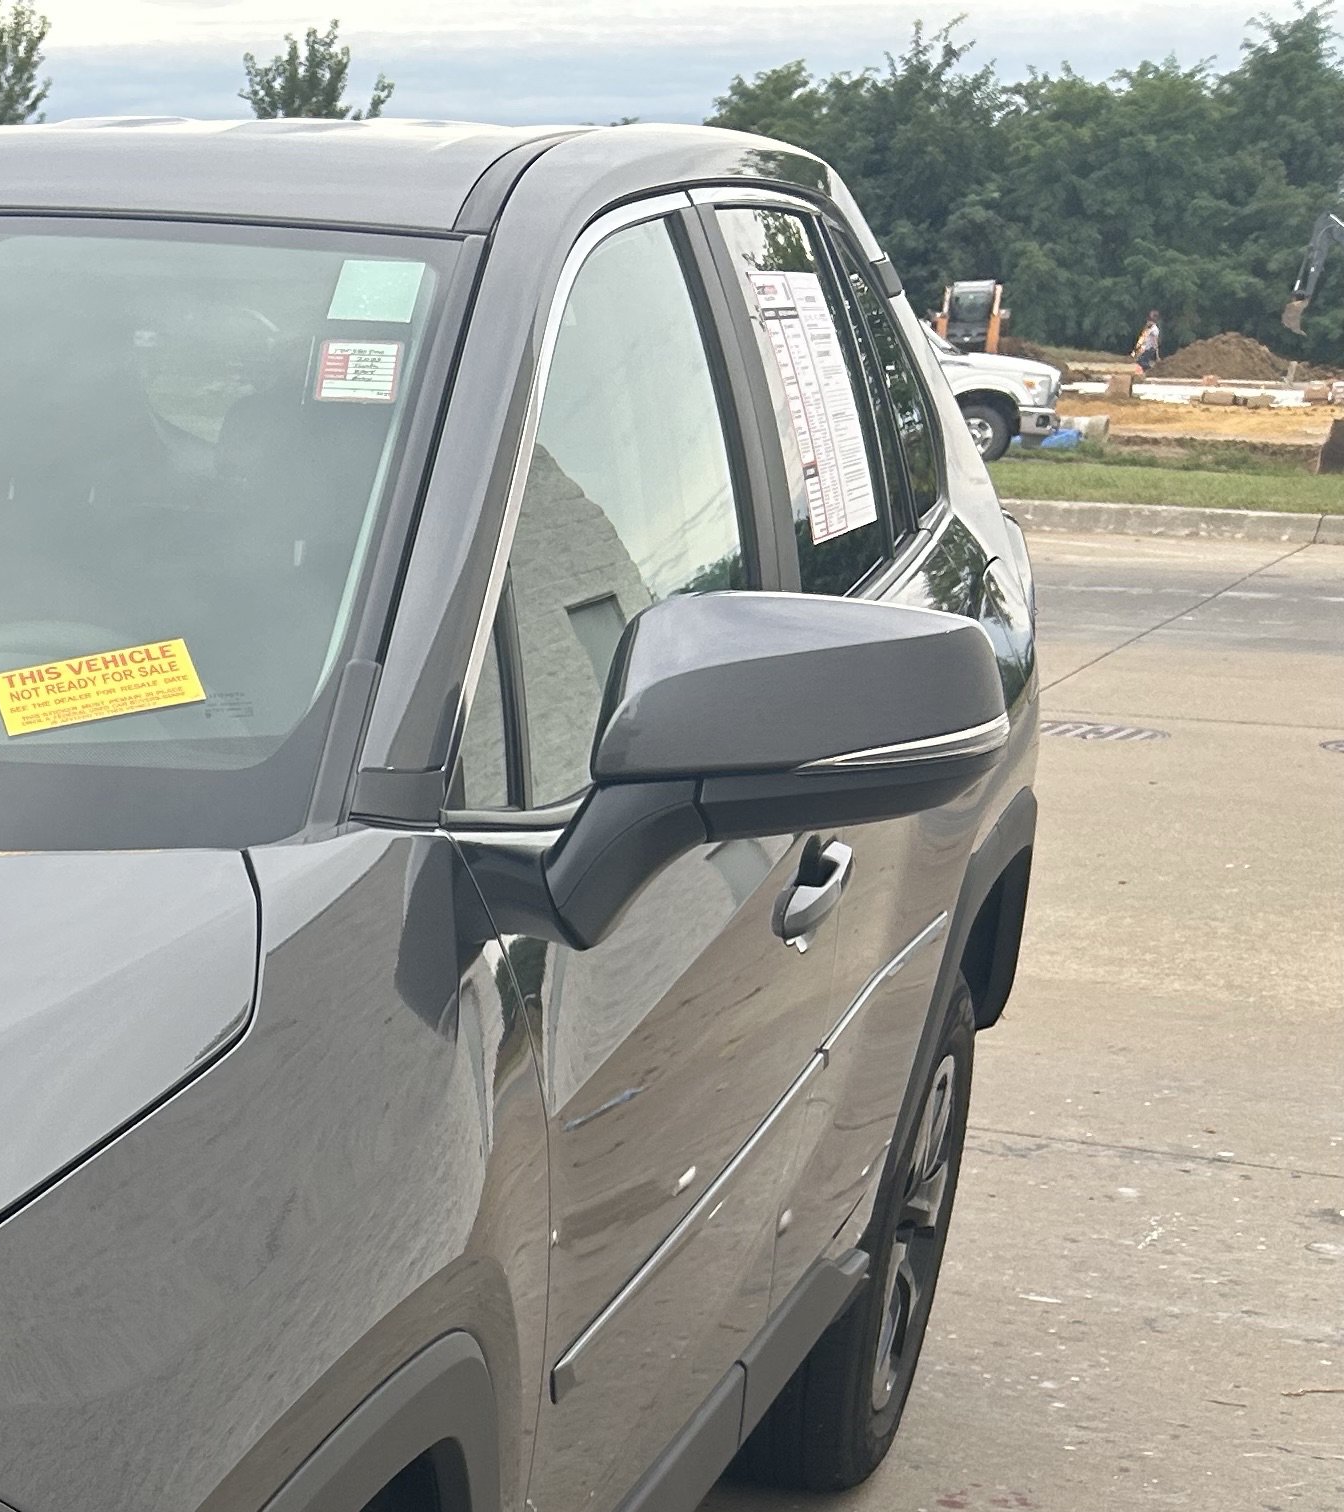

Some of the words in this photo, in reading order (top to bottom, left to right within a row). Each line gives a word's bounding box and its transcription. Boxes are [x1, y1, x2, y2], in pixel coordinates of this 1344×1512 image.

[2, 666, 62, 689] THIS
[66, 644, 176, 676] VEHICLE
[9, 687, 40, 702] NOT
[45, 675, 98, 695] READY
[102, 669, 134, 684] FOR
[138, 661, 180, 677] SALE
[54, 692, 92, 705] DEALER
[120, 680, 158, 692] RESALE
[164, 675, 188, 684] DATE
